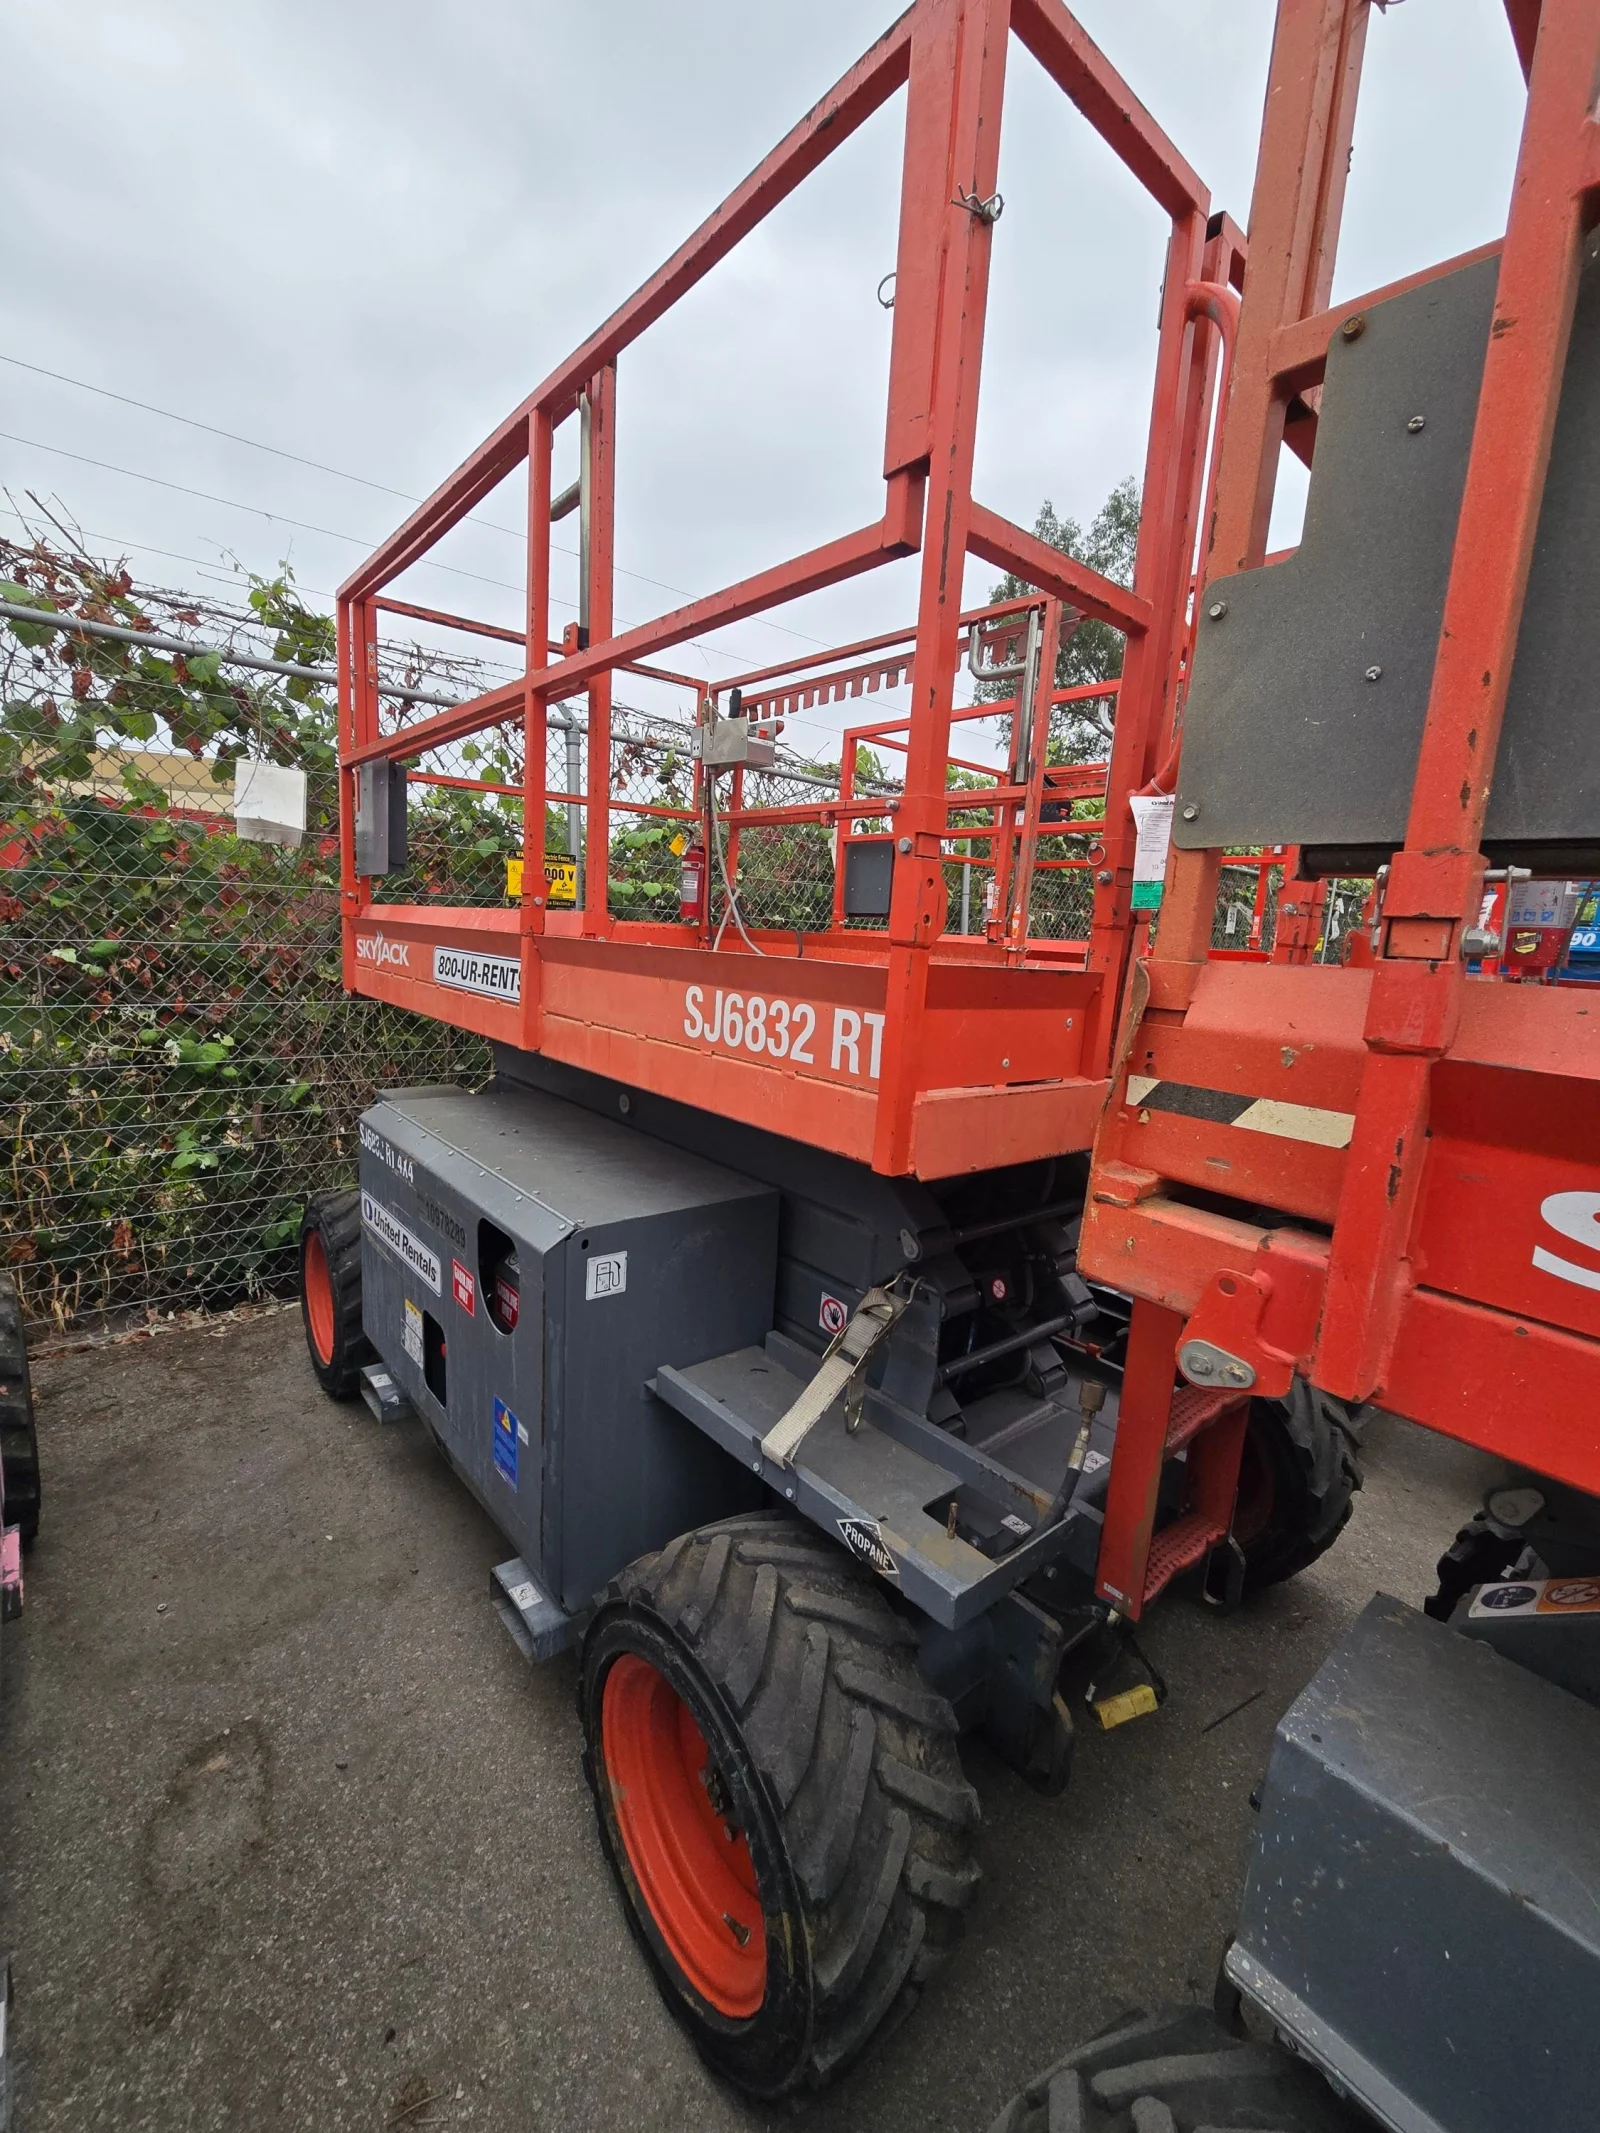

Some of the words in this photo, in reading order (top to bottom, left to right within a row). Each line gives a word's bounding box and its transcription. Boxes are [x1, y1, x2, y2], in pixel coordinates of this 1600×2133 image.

[568, 870, 575, 882] V
[356, 930, 410, 967] SKYJACK
[684, 985, 816, 1065] SJ6832
[374, 1207, 400, 1248] United
[401, 1233, 437, 1282] Rentals
[845, 1522, 890, 1571] PROPANE
